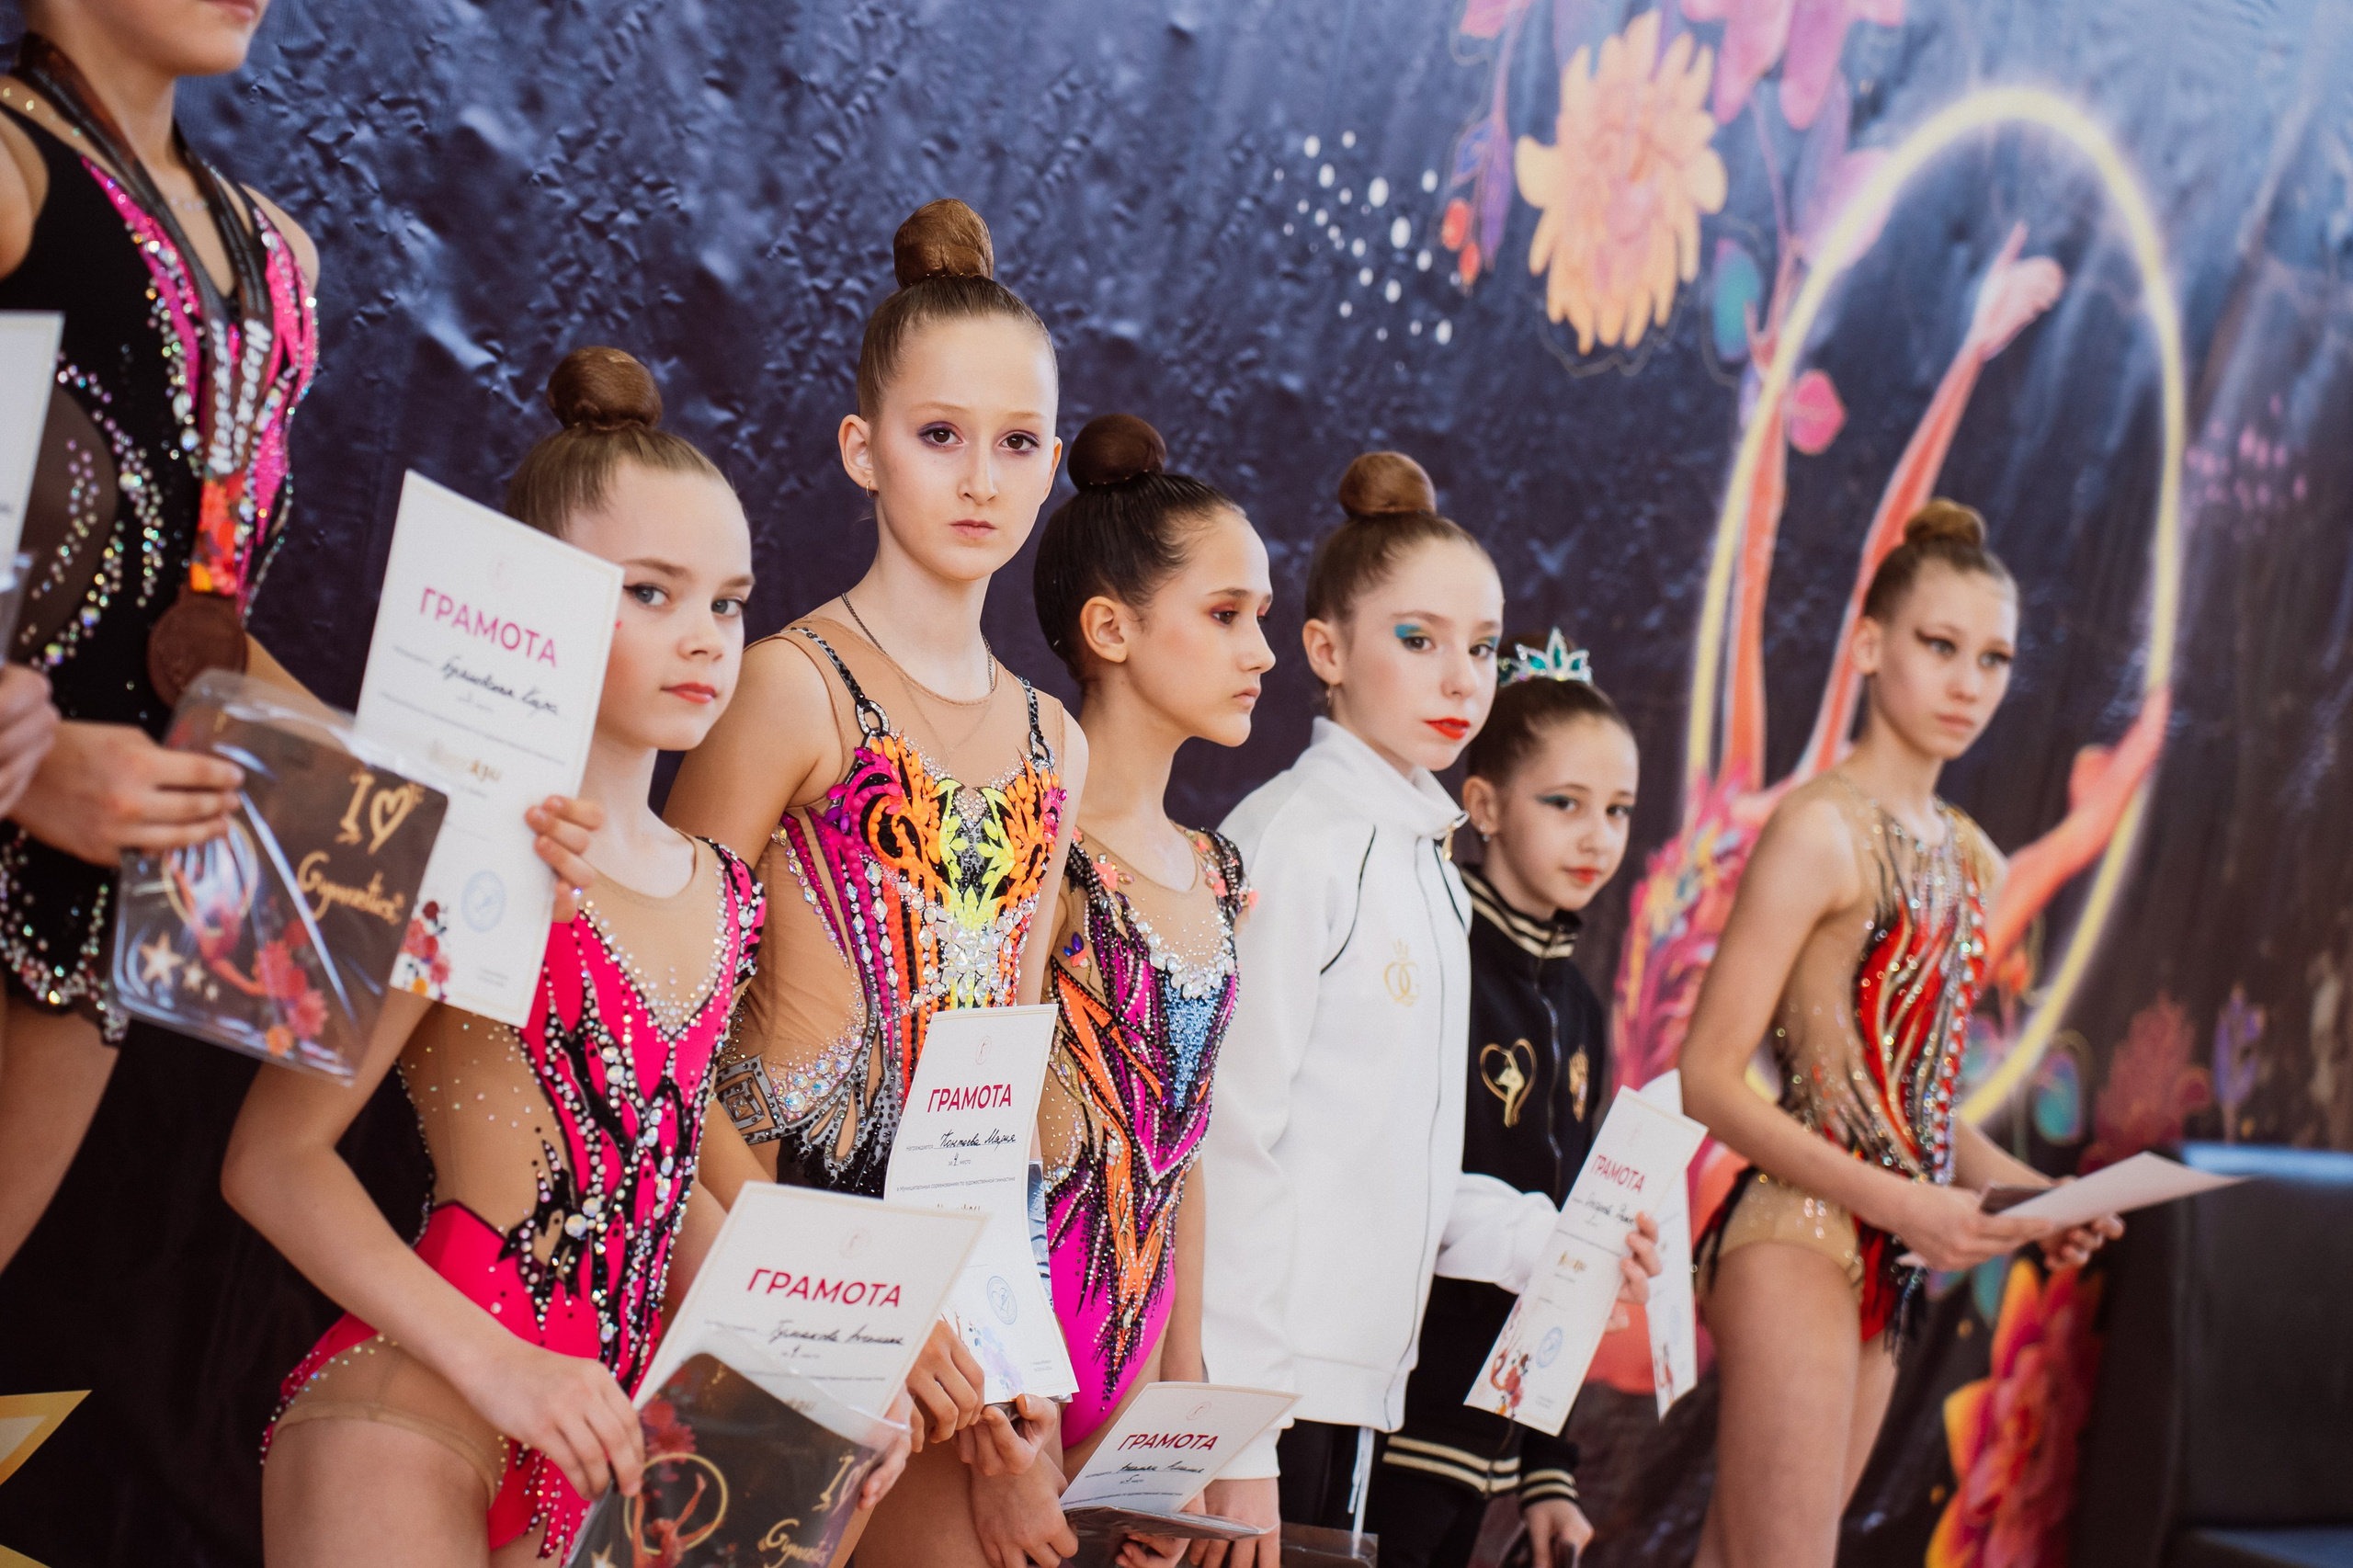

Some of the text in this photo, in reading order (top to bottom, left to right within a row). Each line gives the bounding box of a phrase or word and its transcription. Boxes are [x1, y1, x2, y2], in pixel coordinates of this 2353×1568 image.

[419, 586, 557, 668] ГРАМОТА
[335, 772, 376, 845] I
[927, 1083, 1012, 1113] ГРАМОТА
[984, 1128, 1016, 1153] Мария
[1590, 1154, 1645, 1194] ГРАМОТА
[745, 1267, 903, 1308] ГРАМОТА
[1117, 1432, 1220, 1451] ГРАМОТА
[812, 1449, 856, 1512] I
